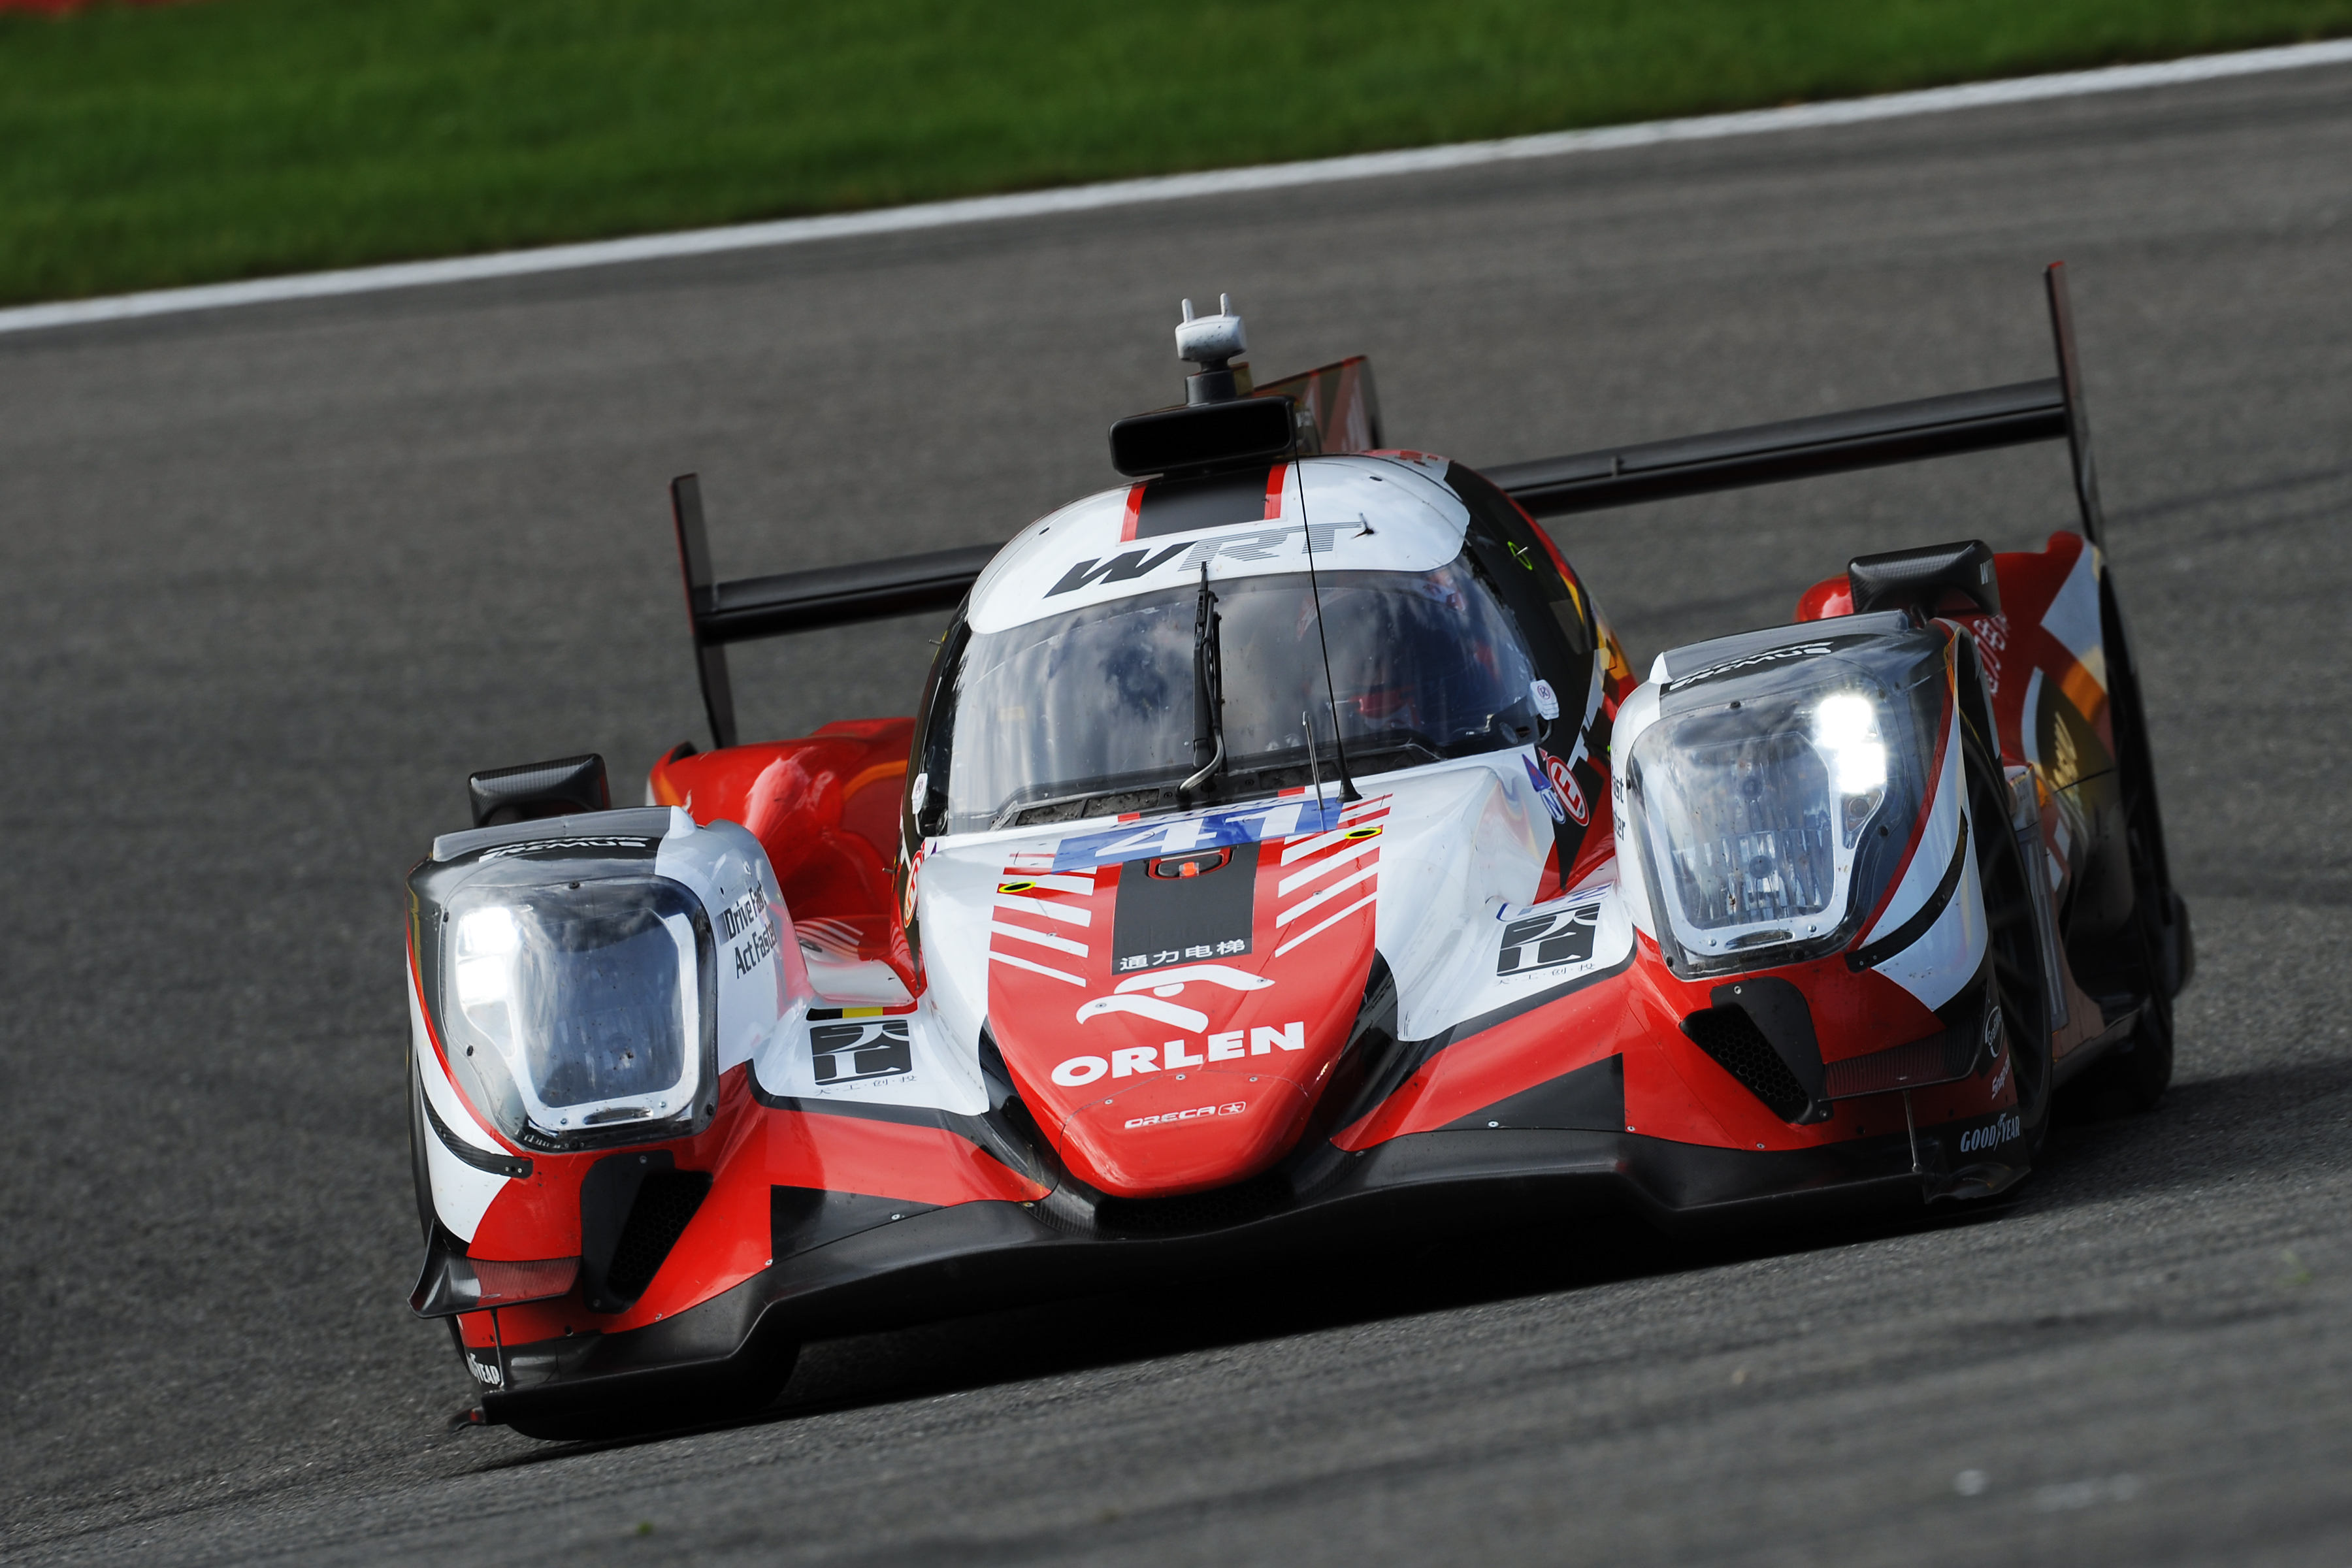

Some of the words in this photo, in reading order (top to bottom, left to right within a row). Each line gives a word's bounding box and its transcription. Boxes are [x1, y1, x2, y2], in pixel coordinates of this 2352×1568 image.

[1043, 521, 1362, 599] WRT
[1094, 804, 1303, 857] 41
[723, 900, 754, 940] Drive
[748, 880, 767, 919] Fast
[734, 941, 757, 979] Act
[751, 920, 777, 963] Faster
[1119, 938, 1245, 972] 通力电梯
[1051, 1021, 1305, 1087] ORLEN
[1124, 1105, 1217, 1130] ORECA
[1960, 1113, 2020, 1152] GOODYEAR
